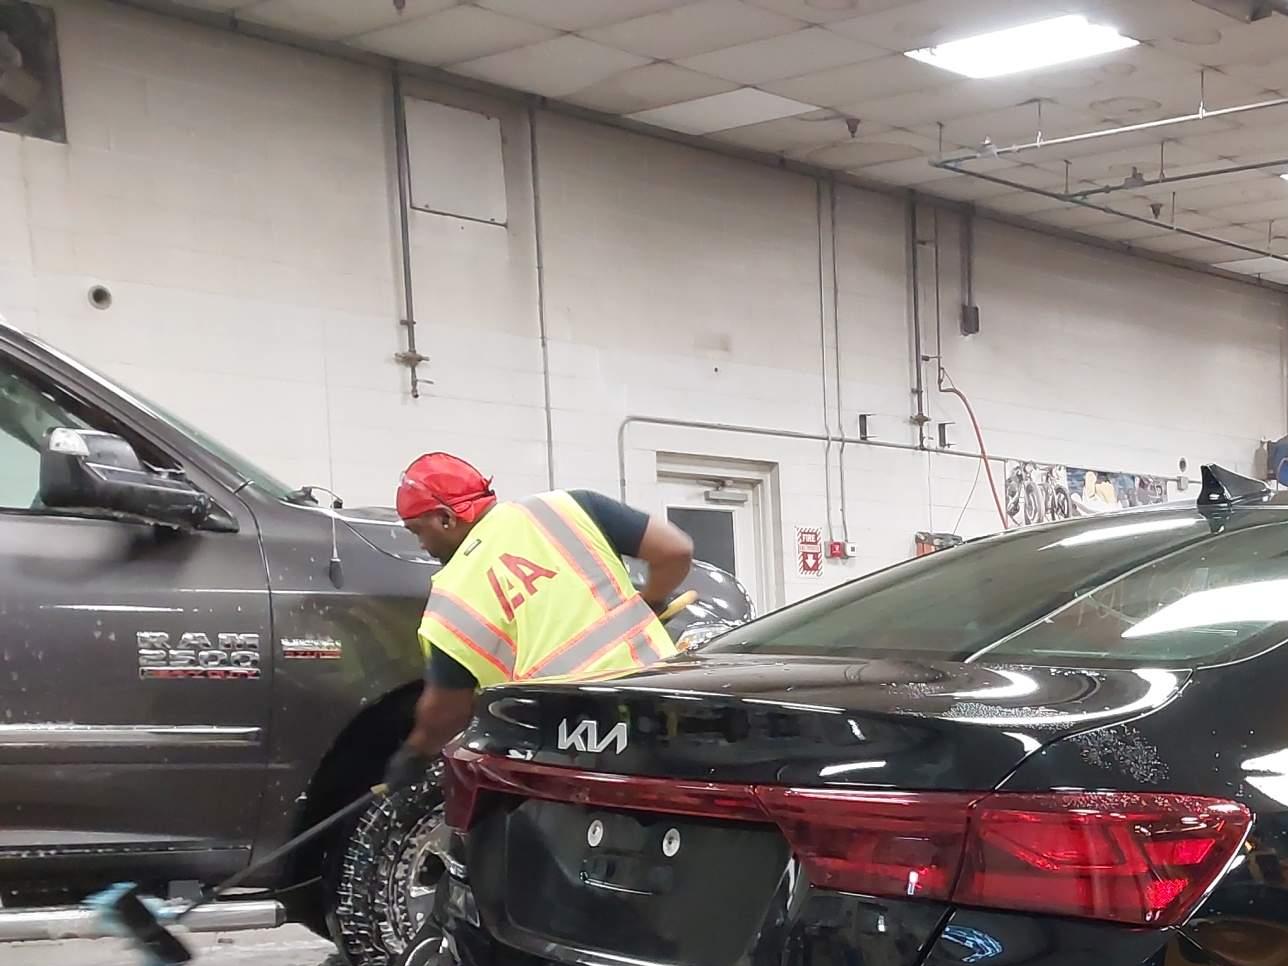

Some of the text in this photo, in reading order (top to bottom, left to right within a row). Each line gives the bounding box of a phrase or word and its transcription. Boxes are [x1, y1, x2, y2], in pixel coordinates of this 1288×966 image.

[802, 533, 816, 543] FIRE
[136, 631, 260, 650] RAM
[138, 649, 260, 667] 2500
[557, 718, 628, 755] KIA
